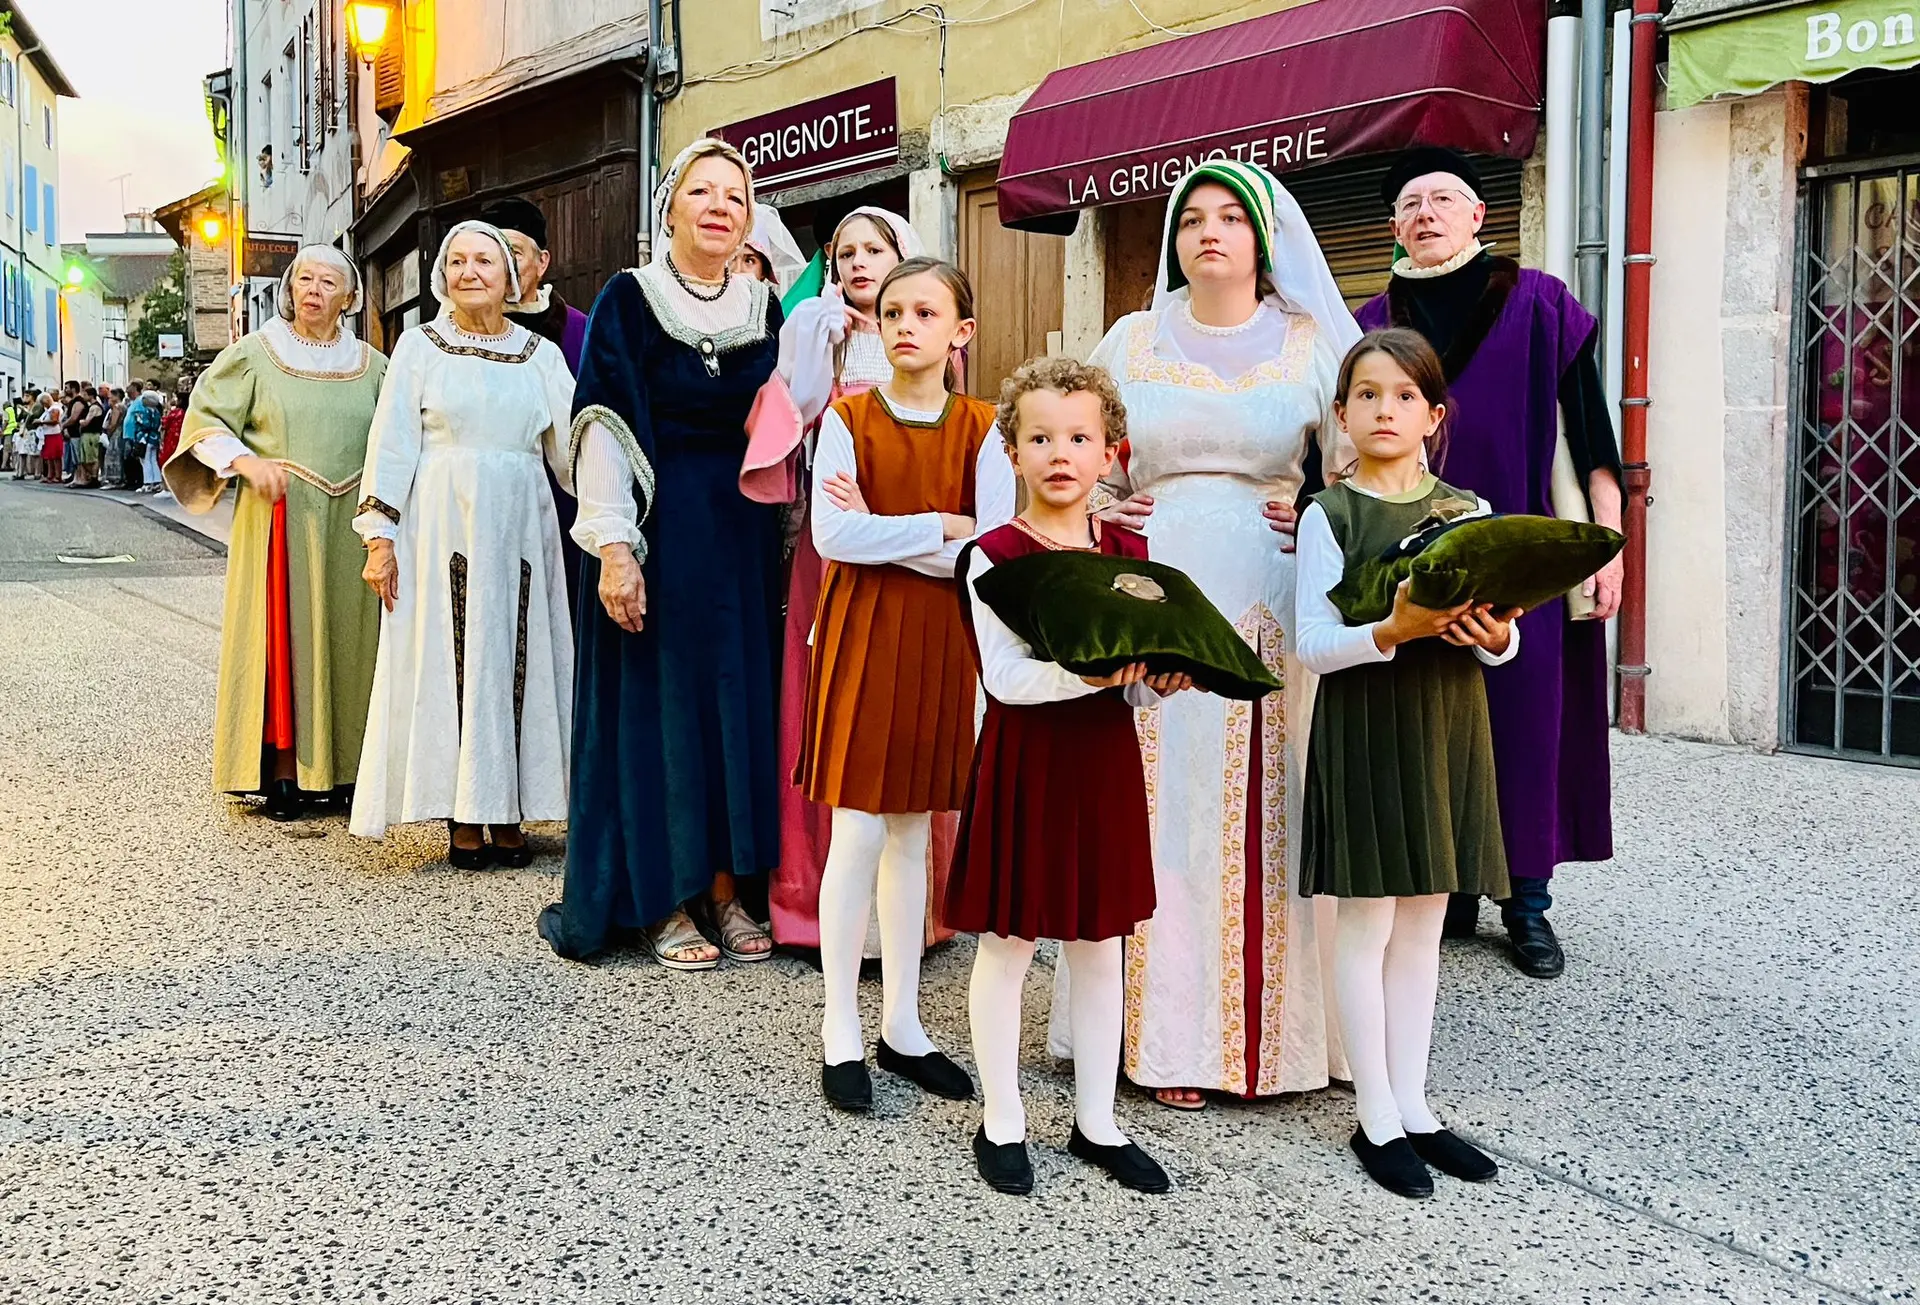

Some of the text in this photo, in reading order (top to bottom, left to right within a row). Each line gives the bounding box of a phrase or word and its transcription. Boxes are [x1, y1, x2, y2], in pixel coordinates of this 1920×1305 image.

[1805, 12, 1915, 61] Bon
[741, 104, 894, 168] GRIGNOTE...
[1068, 174, 1100, 205] LA
